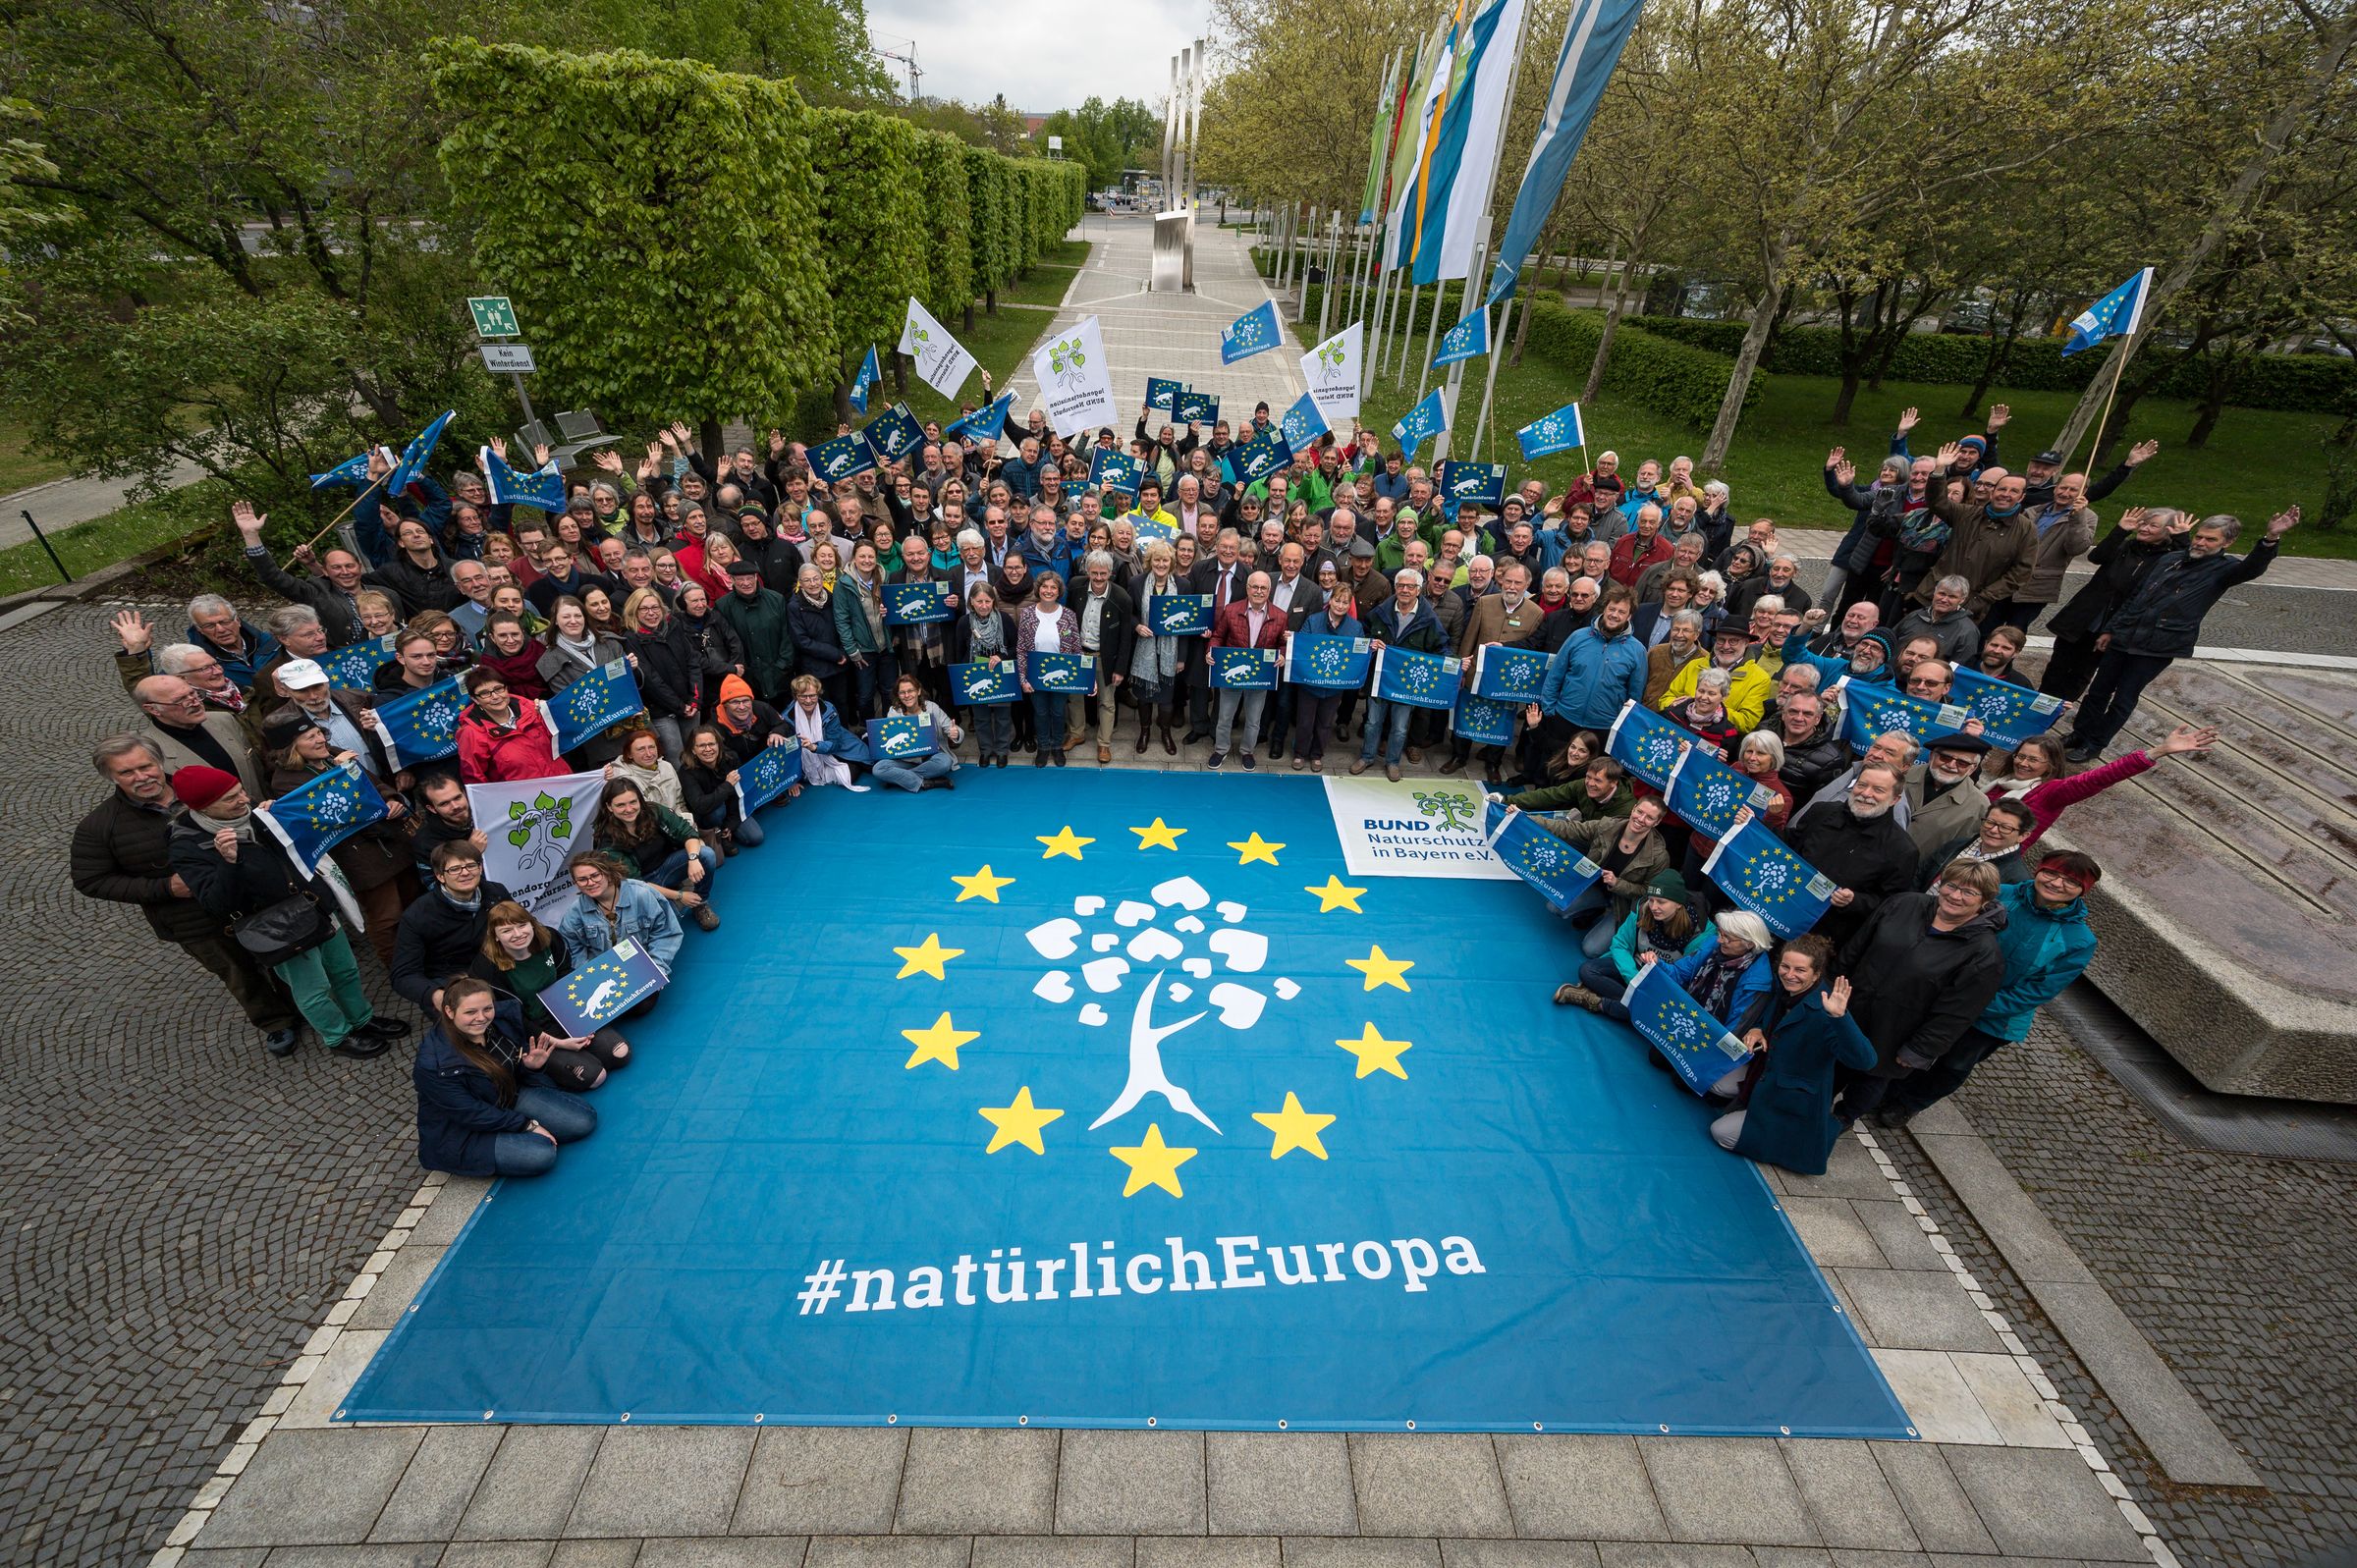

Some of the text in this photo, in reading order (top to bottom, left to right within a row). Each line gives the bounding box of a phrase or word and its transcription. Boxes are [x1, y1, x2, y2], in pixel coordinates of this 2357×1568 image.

[497, 349, 514, 357] Kein
[909, 613, 949, 622] #natürlichEuropa
[977, 692, 1016, 702] #natürlichEuropa
[1391, 691, 1449, 706] #natürlichEuropa
[572, 704, 634, 745] #natürlichEuropa
[1455, 728, 1508, 741] #natürlichEuropa
[894, 745, 933, 757] #natürlichEuropa
[1364, 819, 1430, 831] BUND
[1368, 834, 1487, 847] Naturschutz
[1372, 846, 1494, 861] in Bayern e.V.
[1503, 858, 1564, 900] #natürlichEuropa
[1721, 880, 1791, 934] #natürlichEuropa
[607, 978, 657, 1017] #natürlichEuropa
[1634, 1019, 1698, 1083] #natürlichEuropa
[796, 1233, 1487, 1316] #natürlichEuropa
